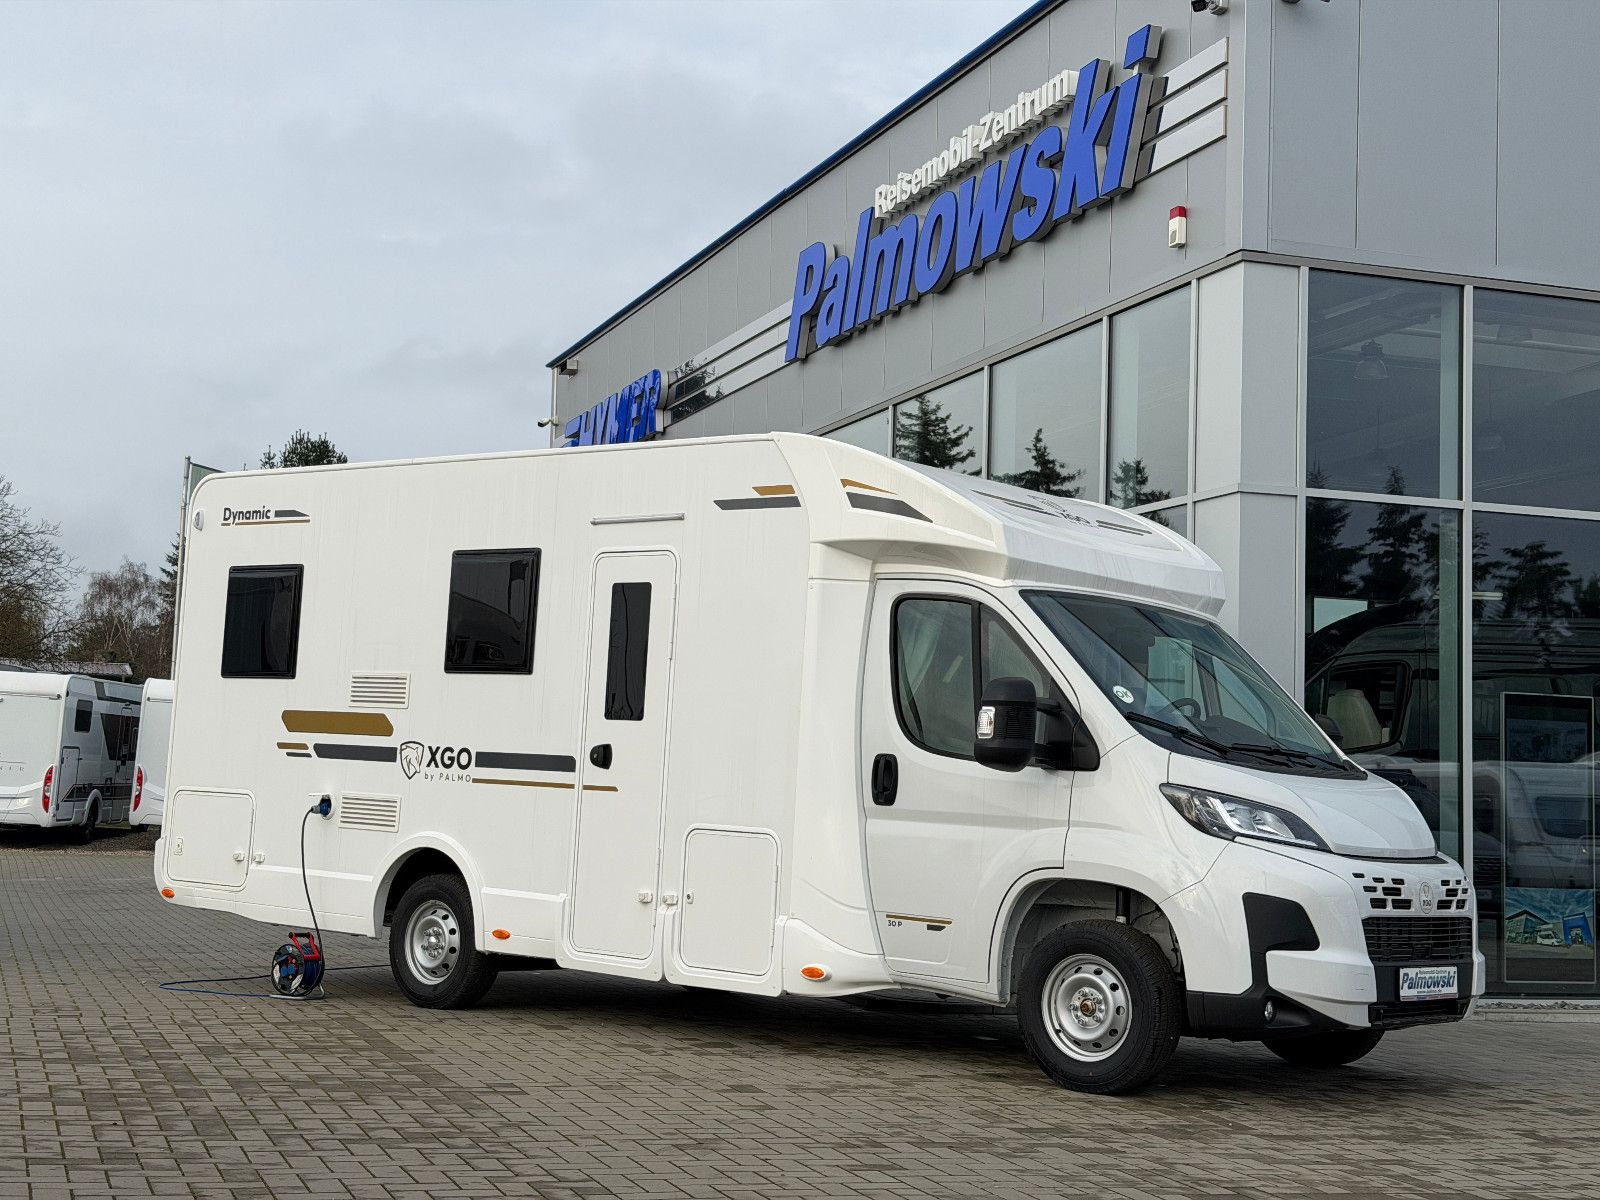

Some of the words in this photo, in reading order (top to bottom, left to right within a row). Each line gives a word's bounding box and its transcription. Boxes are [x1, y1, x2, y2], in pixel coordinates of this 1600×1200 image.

[874, 69, 1076, 219] Reisemobil-Zentrum
[784, 24, 1160, 364] Palmowski
[223, 505, 271, 525] Dynamic
[426, 745, 472, 771] XGO
[424, 771, 435, 782] by
[439, 772, 472, 783] PALMO
[1401, 970, 1456, 990] Palmowski
